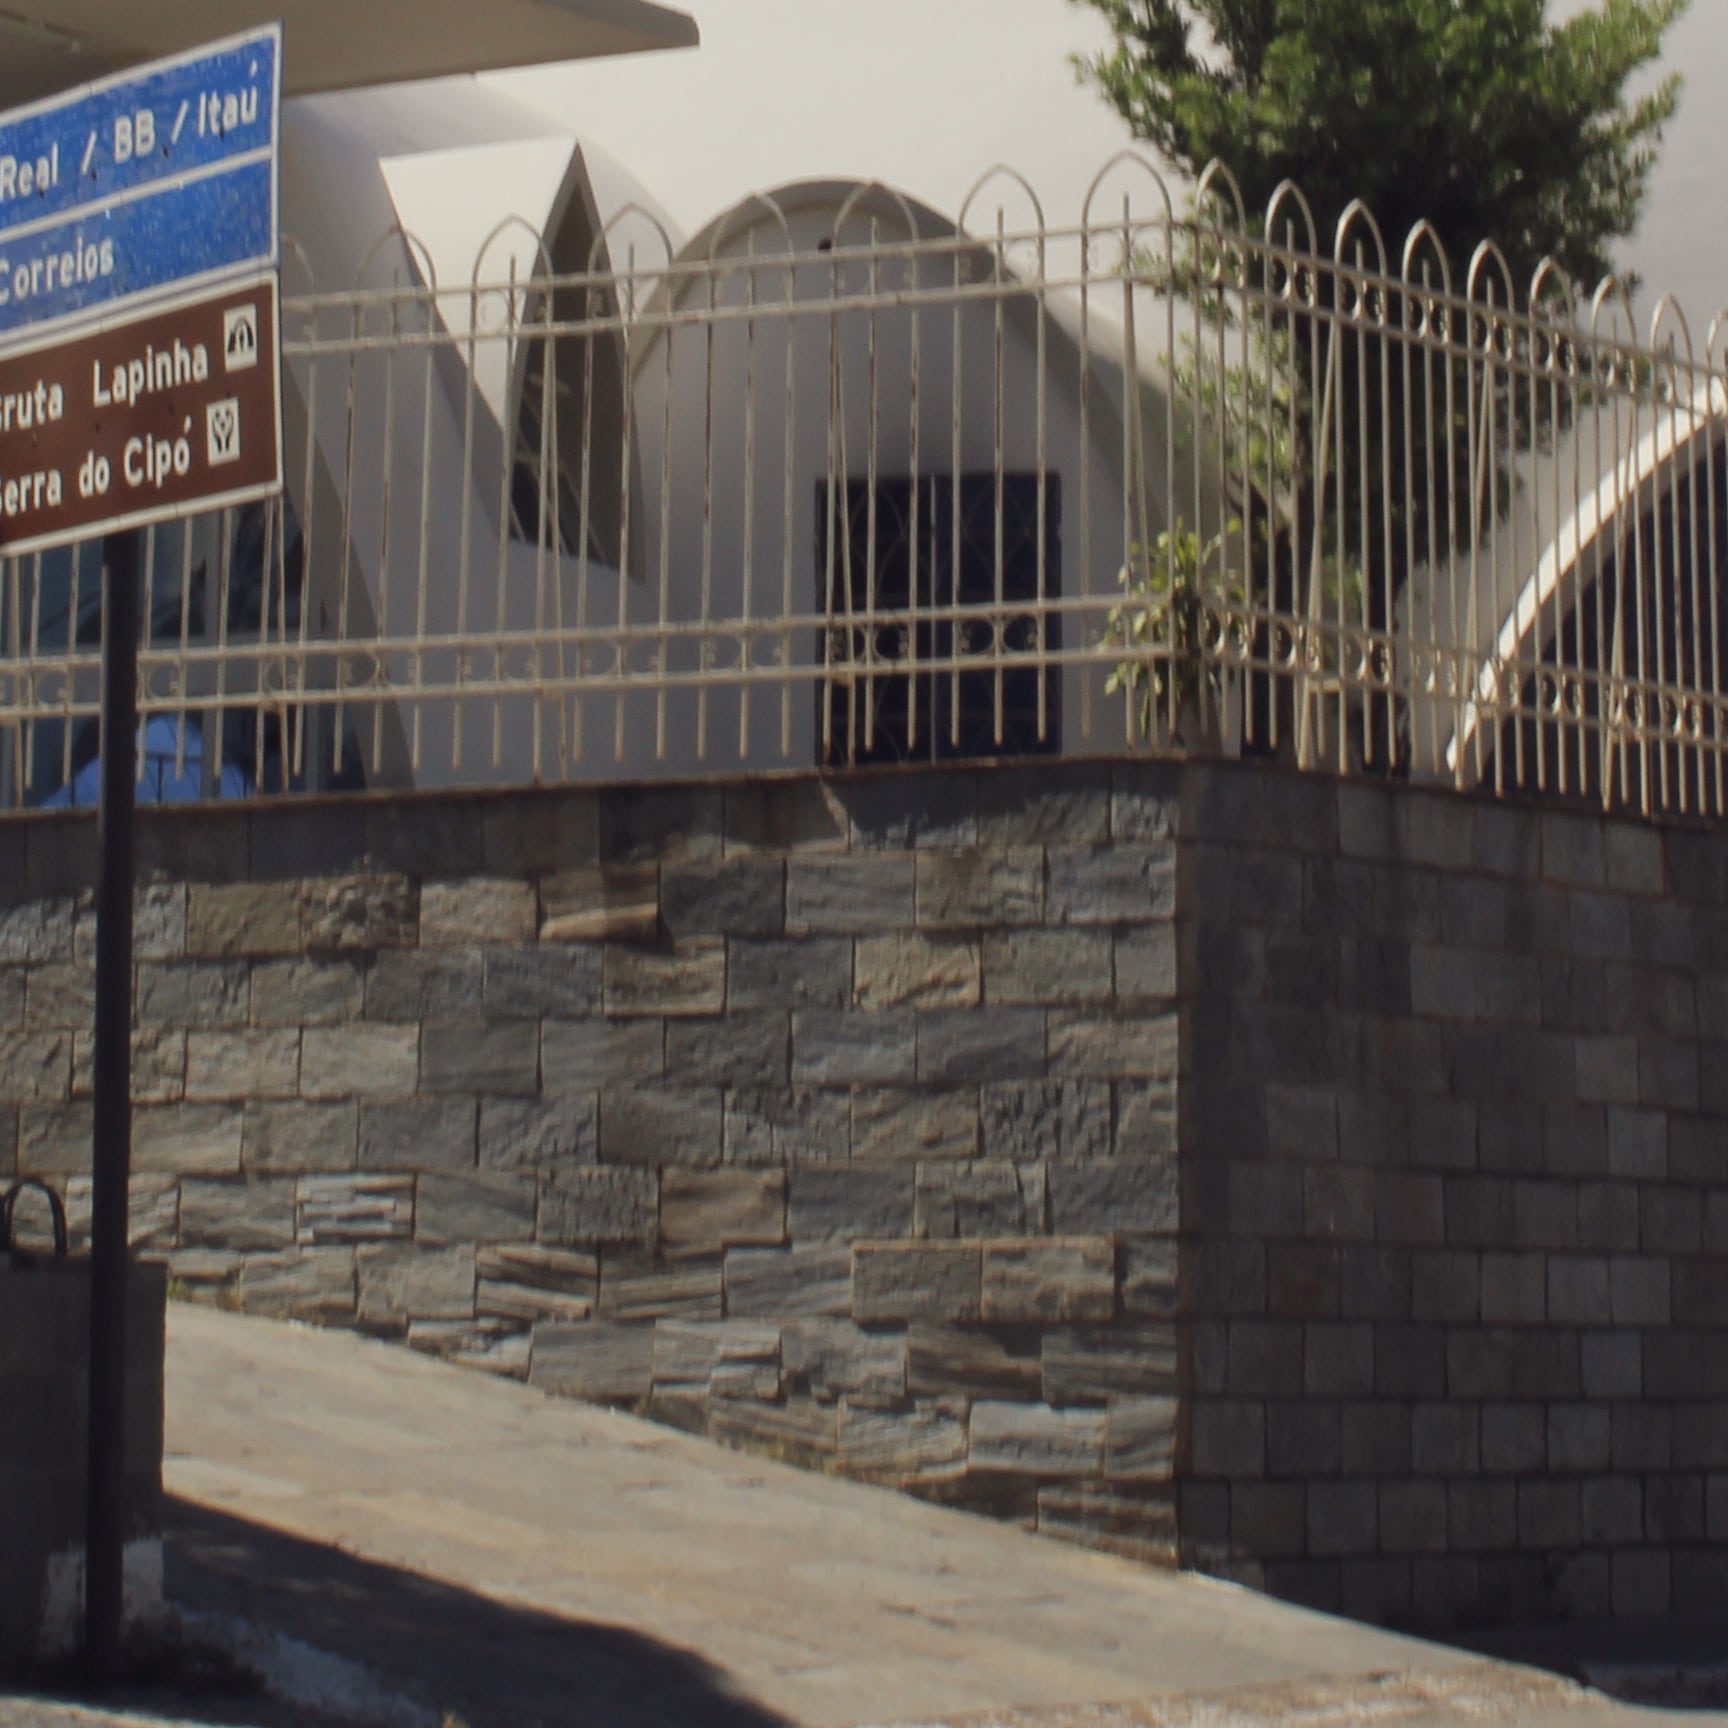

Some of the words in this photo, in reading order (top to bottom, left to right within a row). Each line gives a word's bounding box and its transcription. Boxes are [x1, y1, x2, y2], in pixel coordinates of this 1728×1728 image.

[81, 132, 96, 174] /
[113, 109, 155, 163] BB
[171, 100, 187, 143] /
[198, 59, 258, 137] Itaú
[94, 339, 208, 408] Lapinha
[79, 451, 110, 498] do
[124, 415, 191, 490] Cipó
